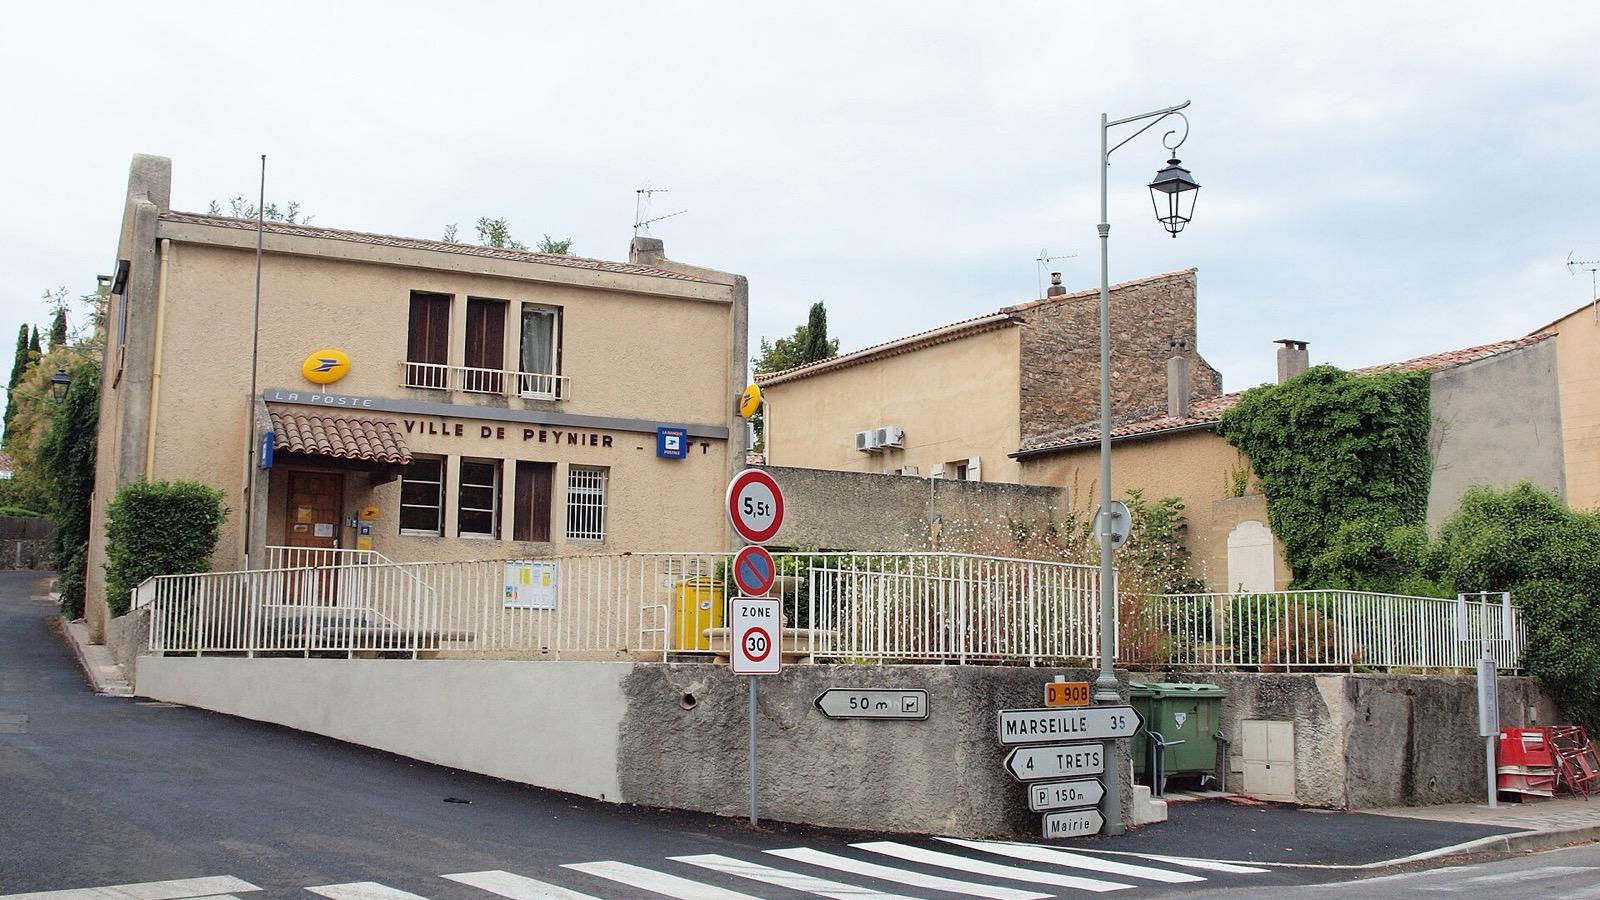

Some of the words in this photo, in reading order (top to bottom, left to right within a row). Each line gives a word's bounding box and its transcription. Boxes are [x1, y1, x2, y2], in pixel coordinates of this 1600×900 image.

[275, 392, 299, 400] LA
[311, 394, 373, 407] POSTE
[404, 420, 464, 437] VILLE
[480, 426, 505, 439] DE
[523, 428, 614, 448] PEYNIER
[743, 496, 770, 518] 5,5t
[742, 606, 771, 618] ZONE
[748, 637, 766, 652] 30
[1048, 687, 1057, 702] D
[1064, 686, 1088, 702] 908
[849, 697, 869, 710] 50
[875, 701, 888, 710] m
[1006, 716, 1088, 735] MARSEILLE
[1110, 715, 1126, 730] 35
[1026, 756, 1034, 771] 4
[1056, 752, 1100, 770] TRETS
[1051, 818, 1090, 833] Mairie
